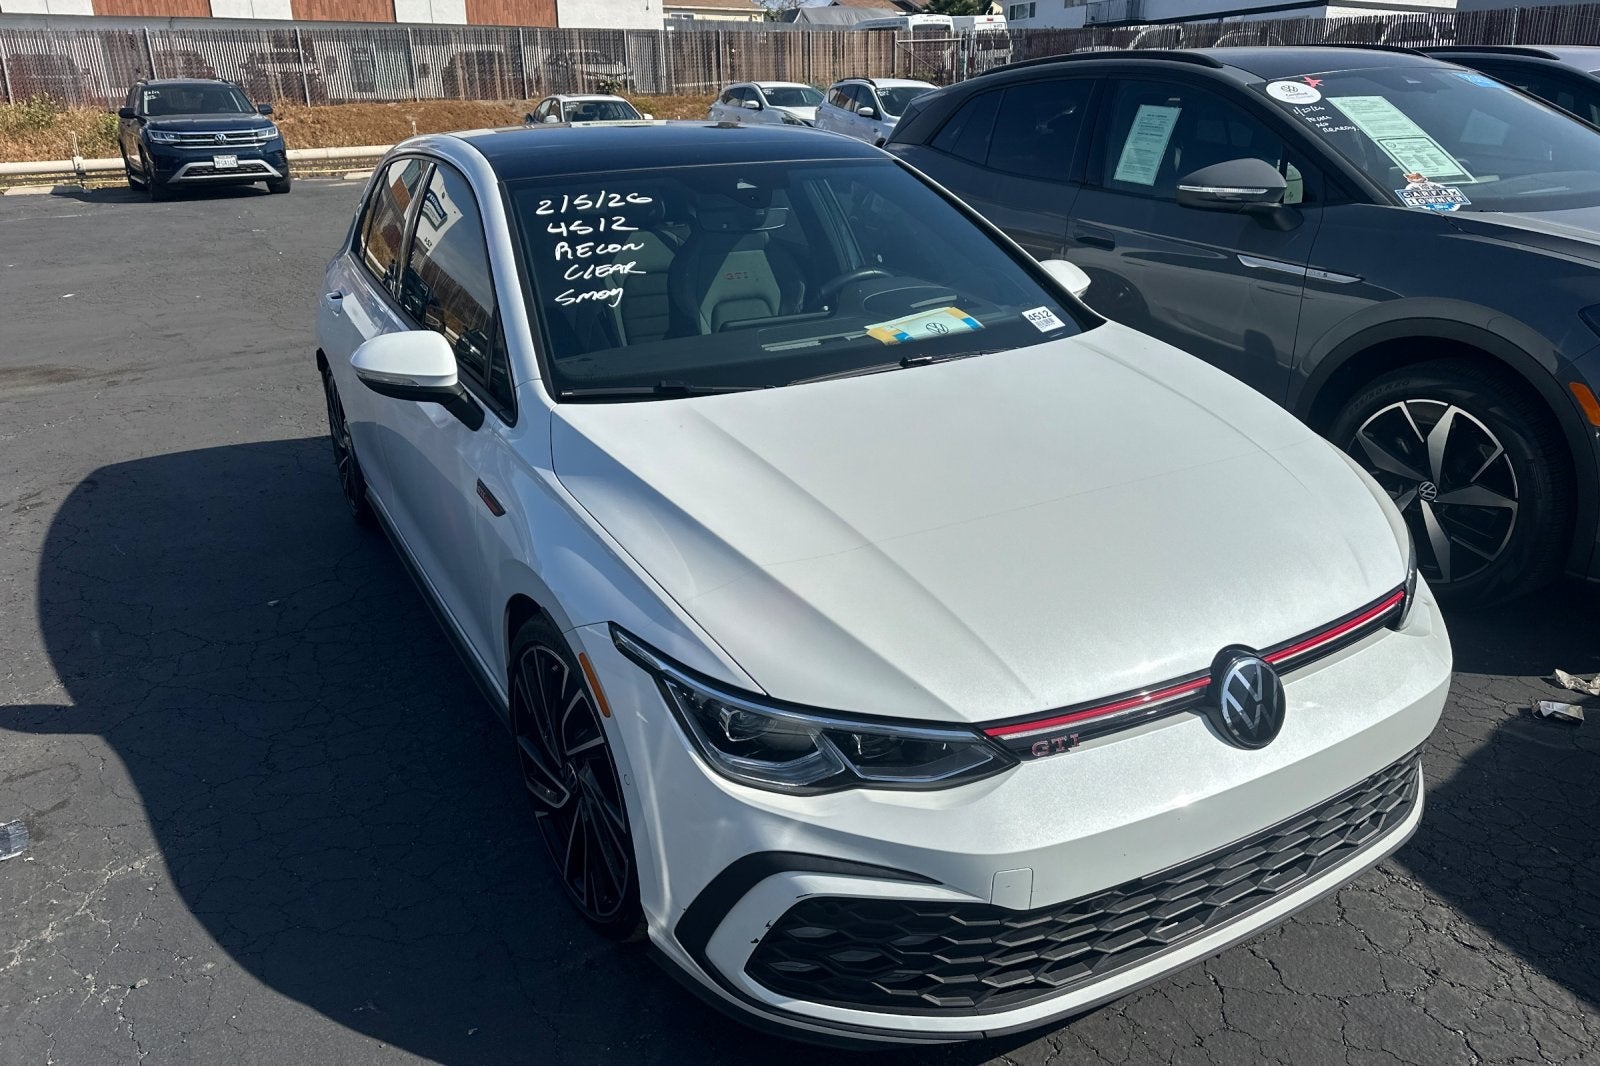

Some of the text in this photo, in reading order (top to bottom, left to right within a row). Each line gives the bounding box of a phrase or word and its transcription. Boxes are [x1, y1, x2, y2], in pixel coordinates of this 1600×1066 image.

[535, 190, 652, 215] 2/5/26
[1403, 189, 1461, 199] CARFAX
[546, 216, 639, 237] 4512
[1028, 310, 1052, 322] 4512
[1031, 733, 1080, 758] GTI
